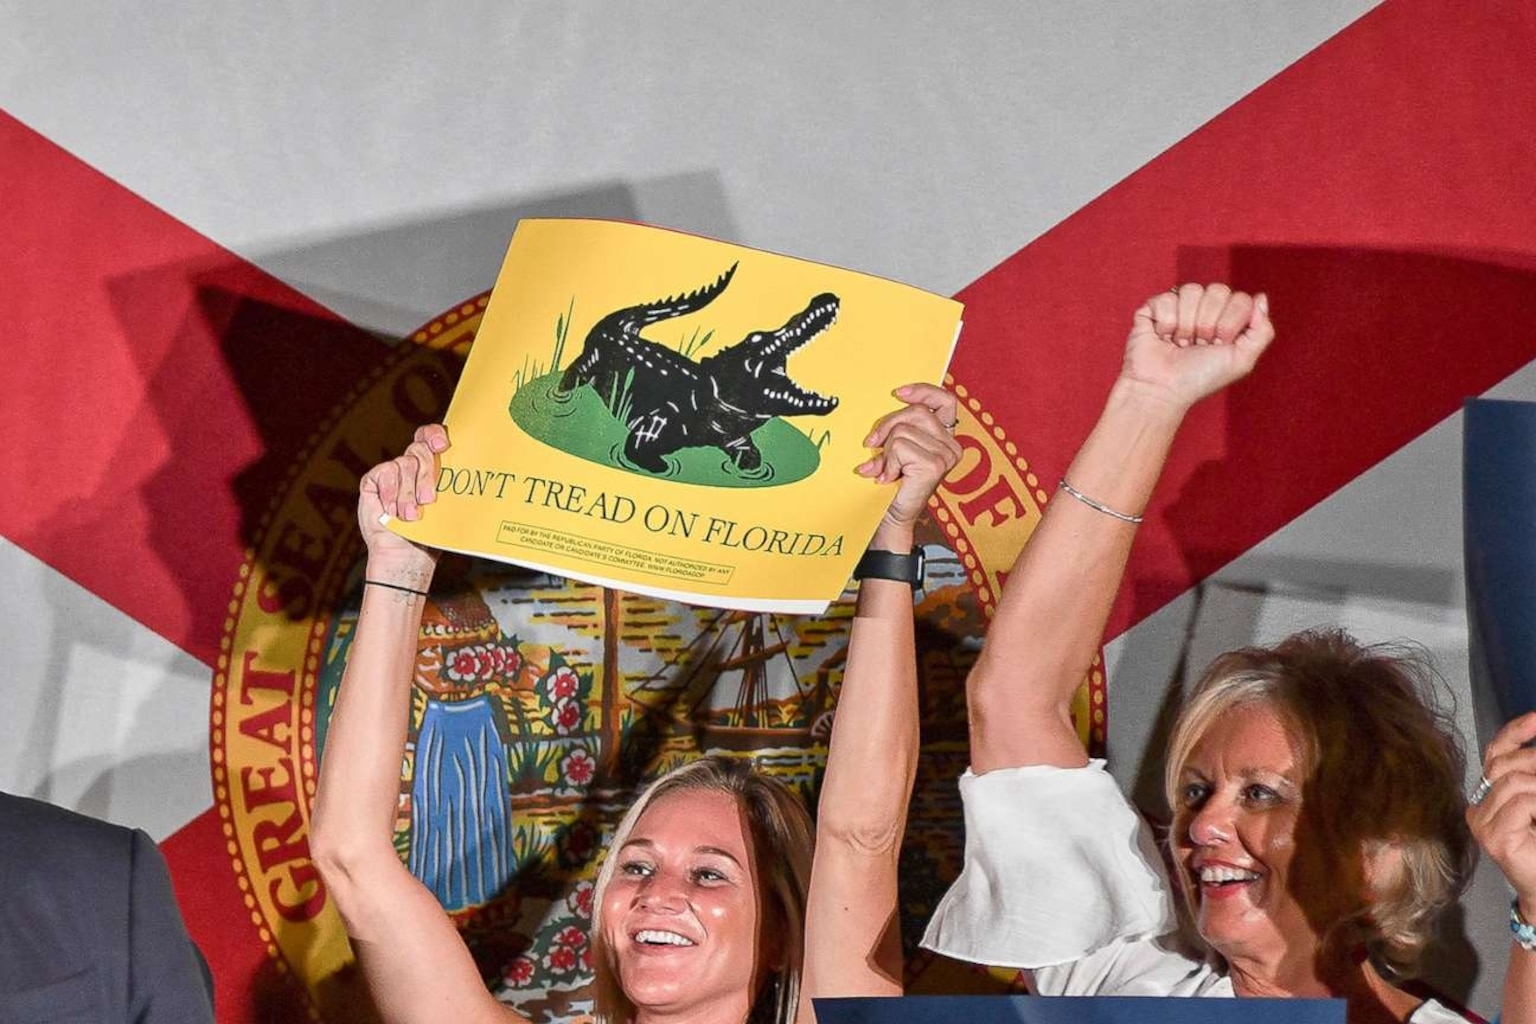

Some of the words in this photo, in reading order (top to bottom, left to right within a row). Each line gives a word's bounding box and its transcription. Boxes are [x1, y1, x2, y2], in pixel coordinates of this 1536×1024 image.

[435, 465, 517, 499] DON'T
[523, 476, 636, 525] TREAD
[643, 503, 695, 539] ON
[705, 517, 846, 557] FLORIDA
[241, 651, 328, 925] GREAT
